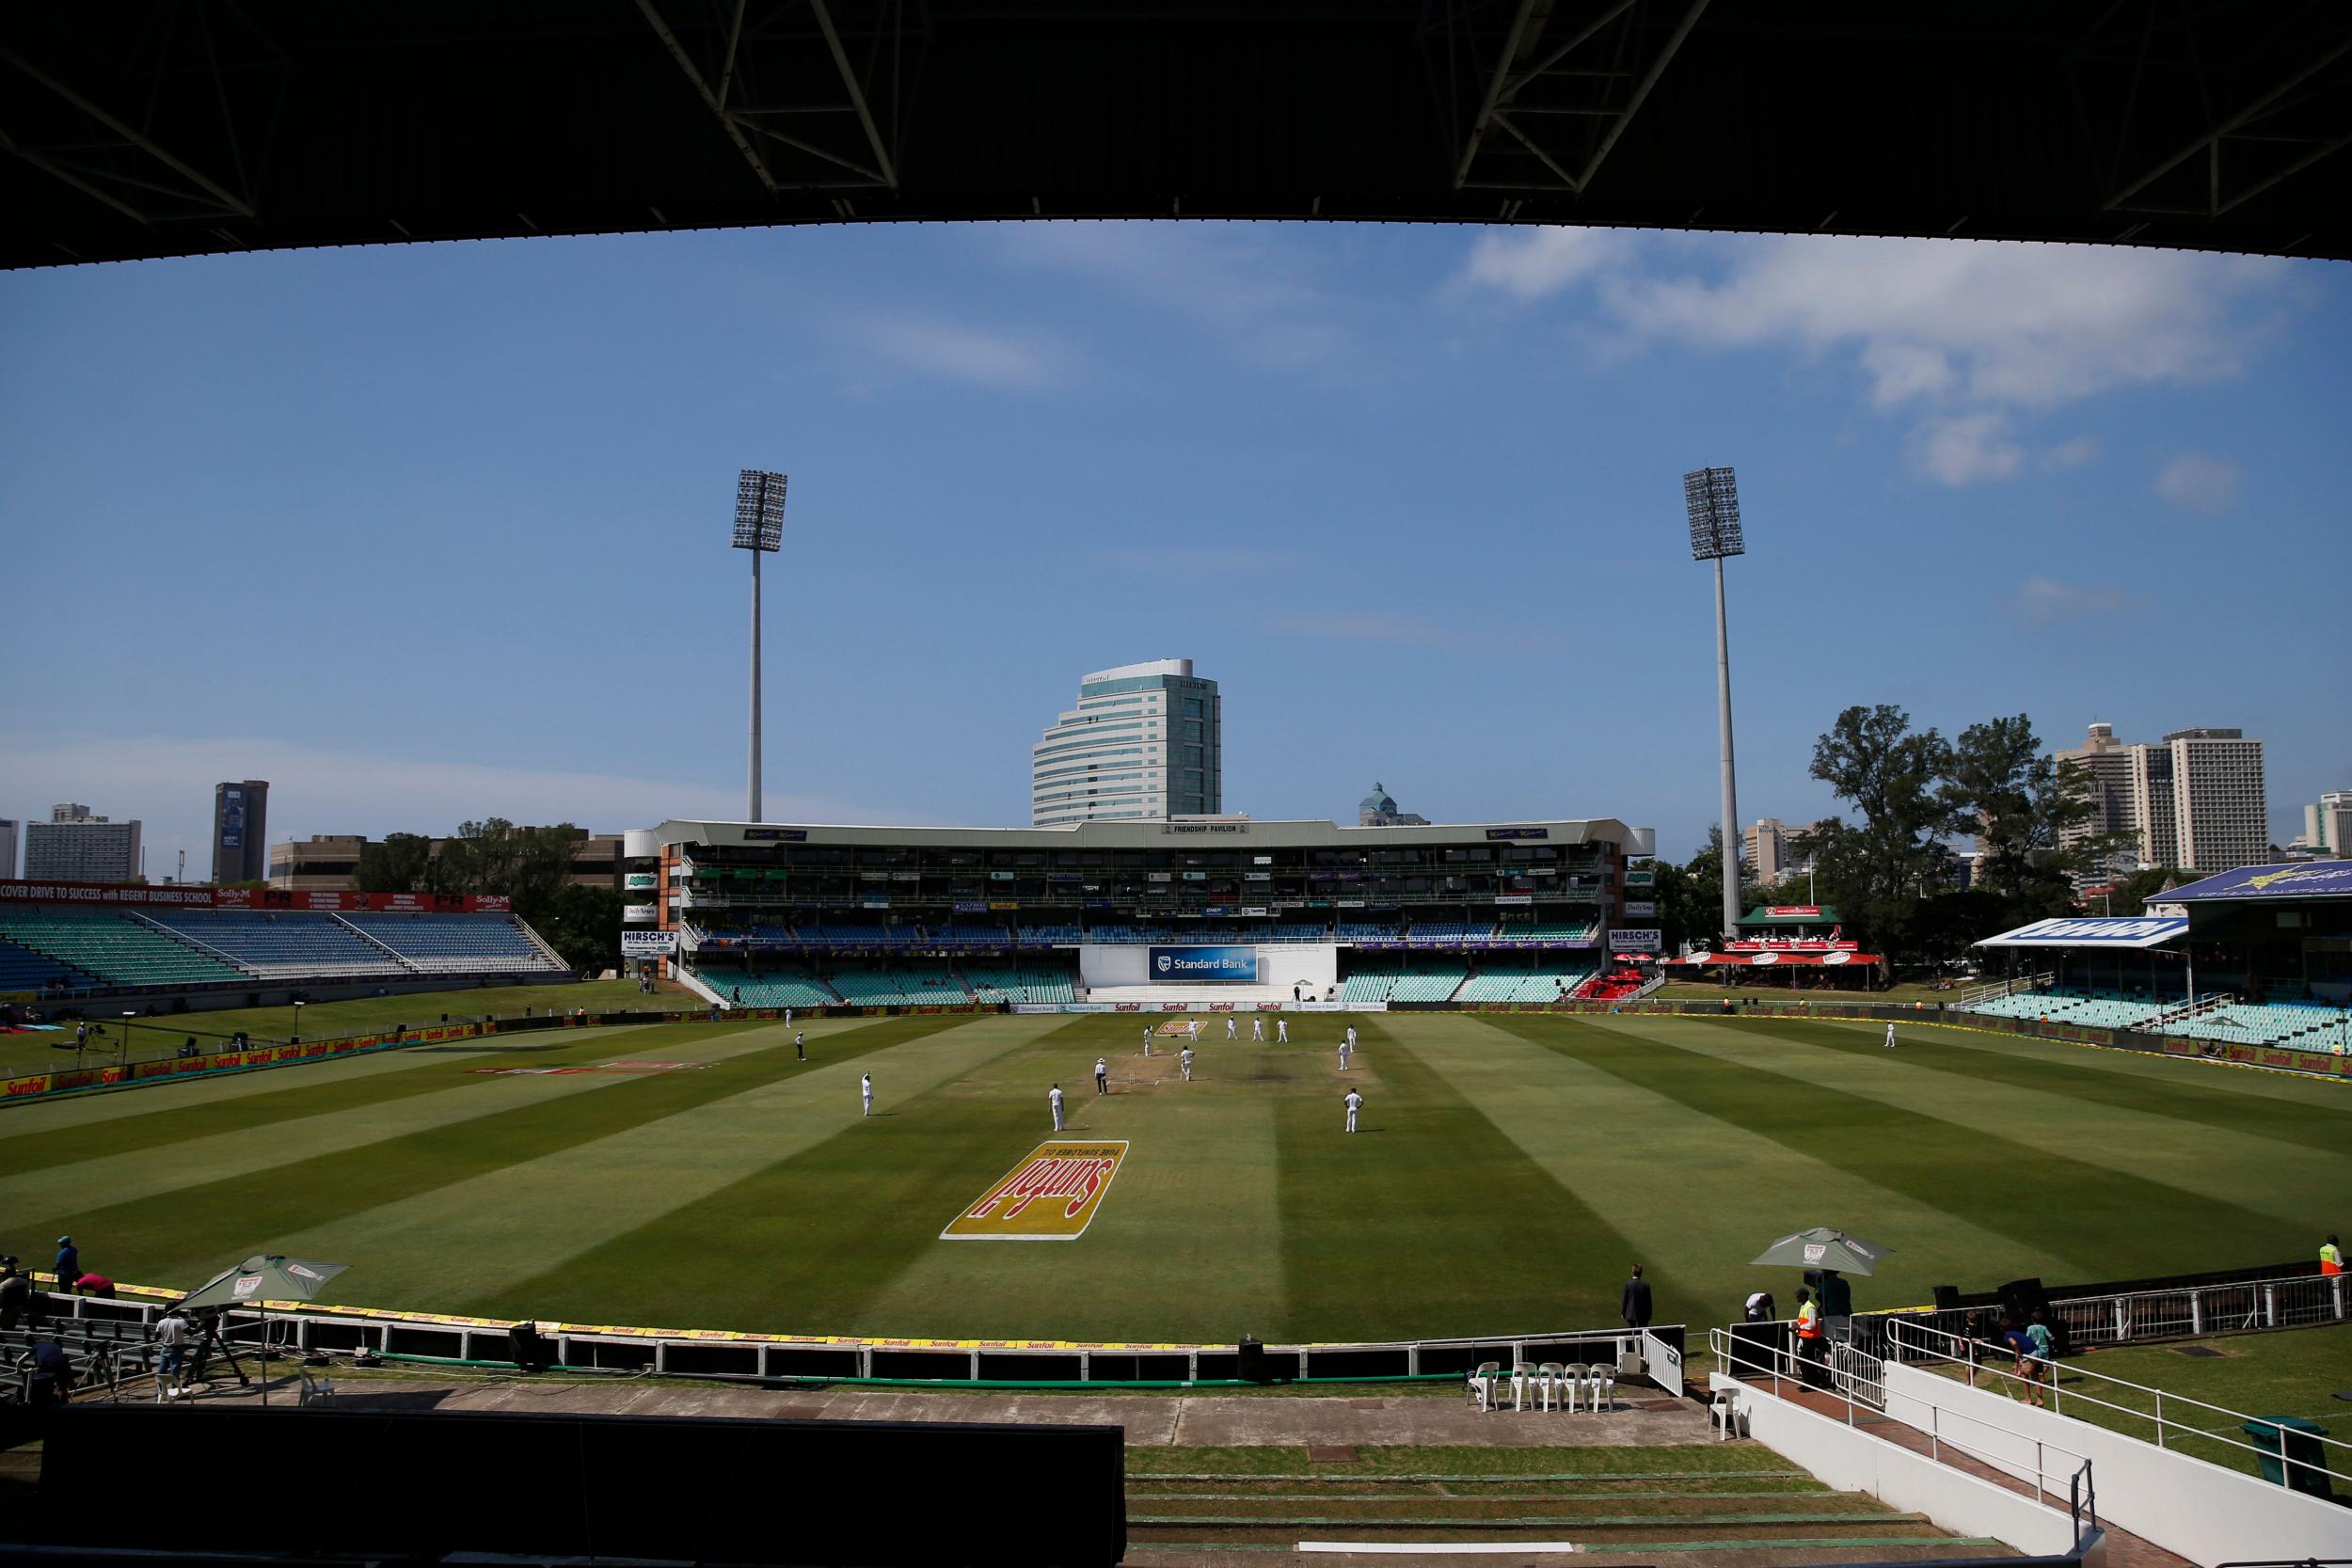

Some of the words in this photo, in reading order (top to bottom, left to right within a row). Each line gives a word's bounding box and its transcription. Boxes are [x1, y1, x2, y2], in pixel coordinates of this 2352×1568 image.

[1, 885, 27, 897] COVER
[31, 886, 55, 898] DRIVE
[56, 887, 67, 898] TO
[69, 888, 102, 900] SUCCESS
[103, 890, 118, 900] with
[119, 890, 147, 901] REGENT
[150, 891, 183, 902] BUSINESS
[184, 892, 212, 903] SCHOOL
[624, 932, 675, 941] HIRSCH'S
[1612, 931, 1659, 940] HIRSCH'S
[1174, 958, 1219, 969] Standard
[1222, 958, 1248, 969] Bank
[917, 1006, 941, 1015] Sunfoil
[948, 1005, 975, 1015] Sunfoil
[1114, 1002, 1140, 1011] Sunfoil
[1162, 1002, 1187, 1011] Sunfoil
[1209, 1002, 1235, 1011] Sunfoil
[1256, 1002, 1281, 1011] Sunfoil
[1486, 1003, 1510, 1011] Sunfoil
[1518, 1003, 1544, 1011] Sunfoil
[1550, 1004, 1576, 1012] Sunfoil
[1582, 1004, 1609, 1013] Sunfoil
[278, 1045, 301, 1059] Sunfoil
[305, 1042, 327, 1055] Sunfoil
[246, 1050, 273, 1064] Sunfoil
[2229, 1046, 2257, 1062] Sunfoil
[2263, 1049, 2293, 1066] Sunfoil
[179, 1057, 207, 1072] Sunfoil
[214, 1053, 241, 1069] Sunfoil
[2297, 1053, 2332, 1071] Sunfoil
[8, 1076, 46, 1095] Sunfoil
[965, 1158, 1115, 1220] Sunfoil
[698, 1331, 724, 1339] Sunfoil
